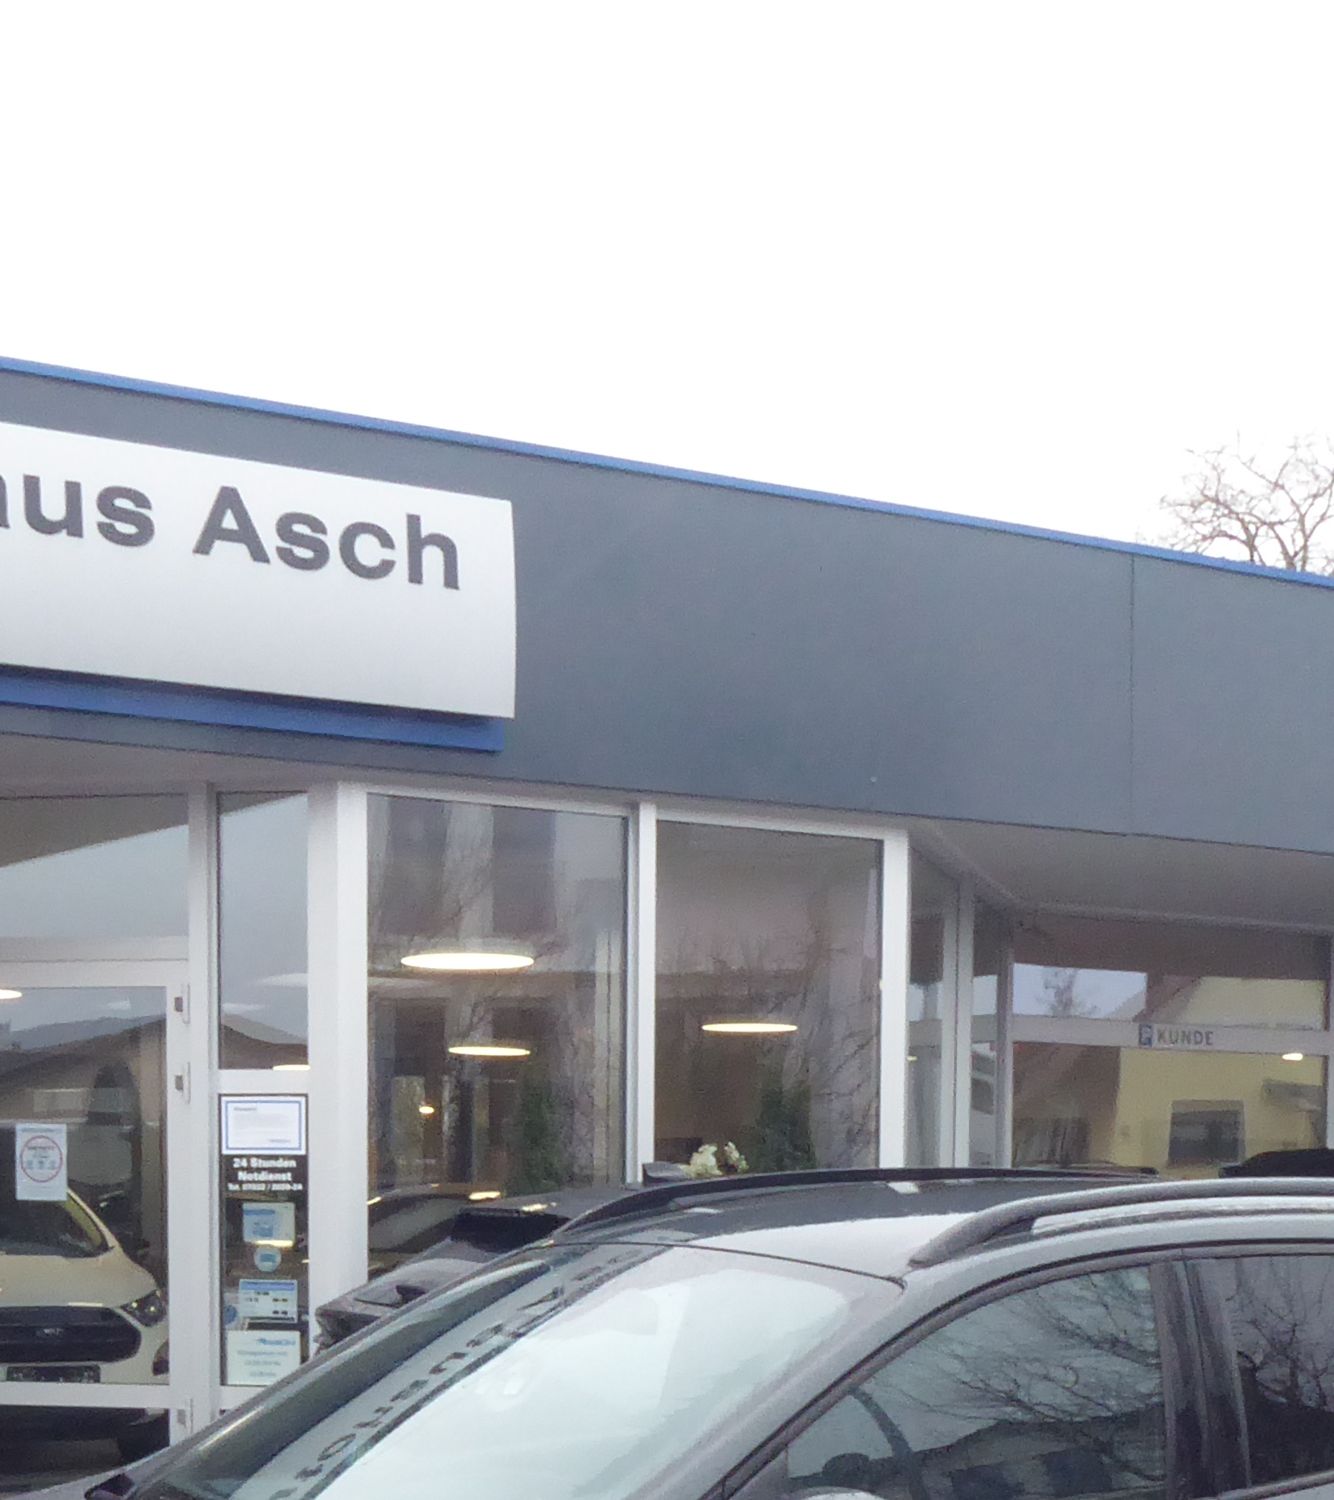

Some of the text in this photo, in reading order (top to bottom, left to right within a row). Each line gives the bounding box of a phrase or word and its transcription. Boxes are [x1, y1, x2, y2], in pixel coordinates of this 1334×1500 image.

[192, 485, 461, 591] Asch
[1156, 1029, 1214, 1046] KUNDE
[232, 1156, 297, 1168] 24 Stunden
[237, 1171, 292, 1181] Notdienst
